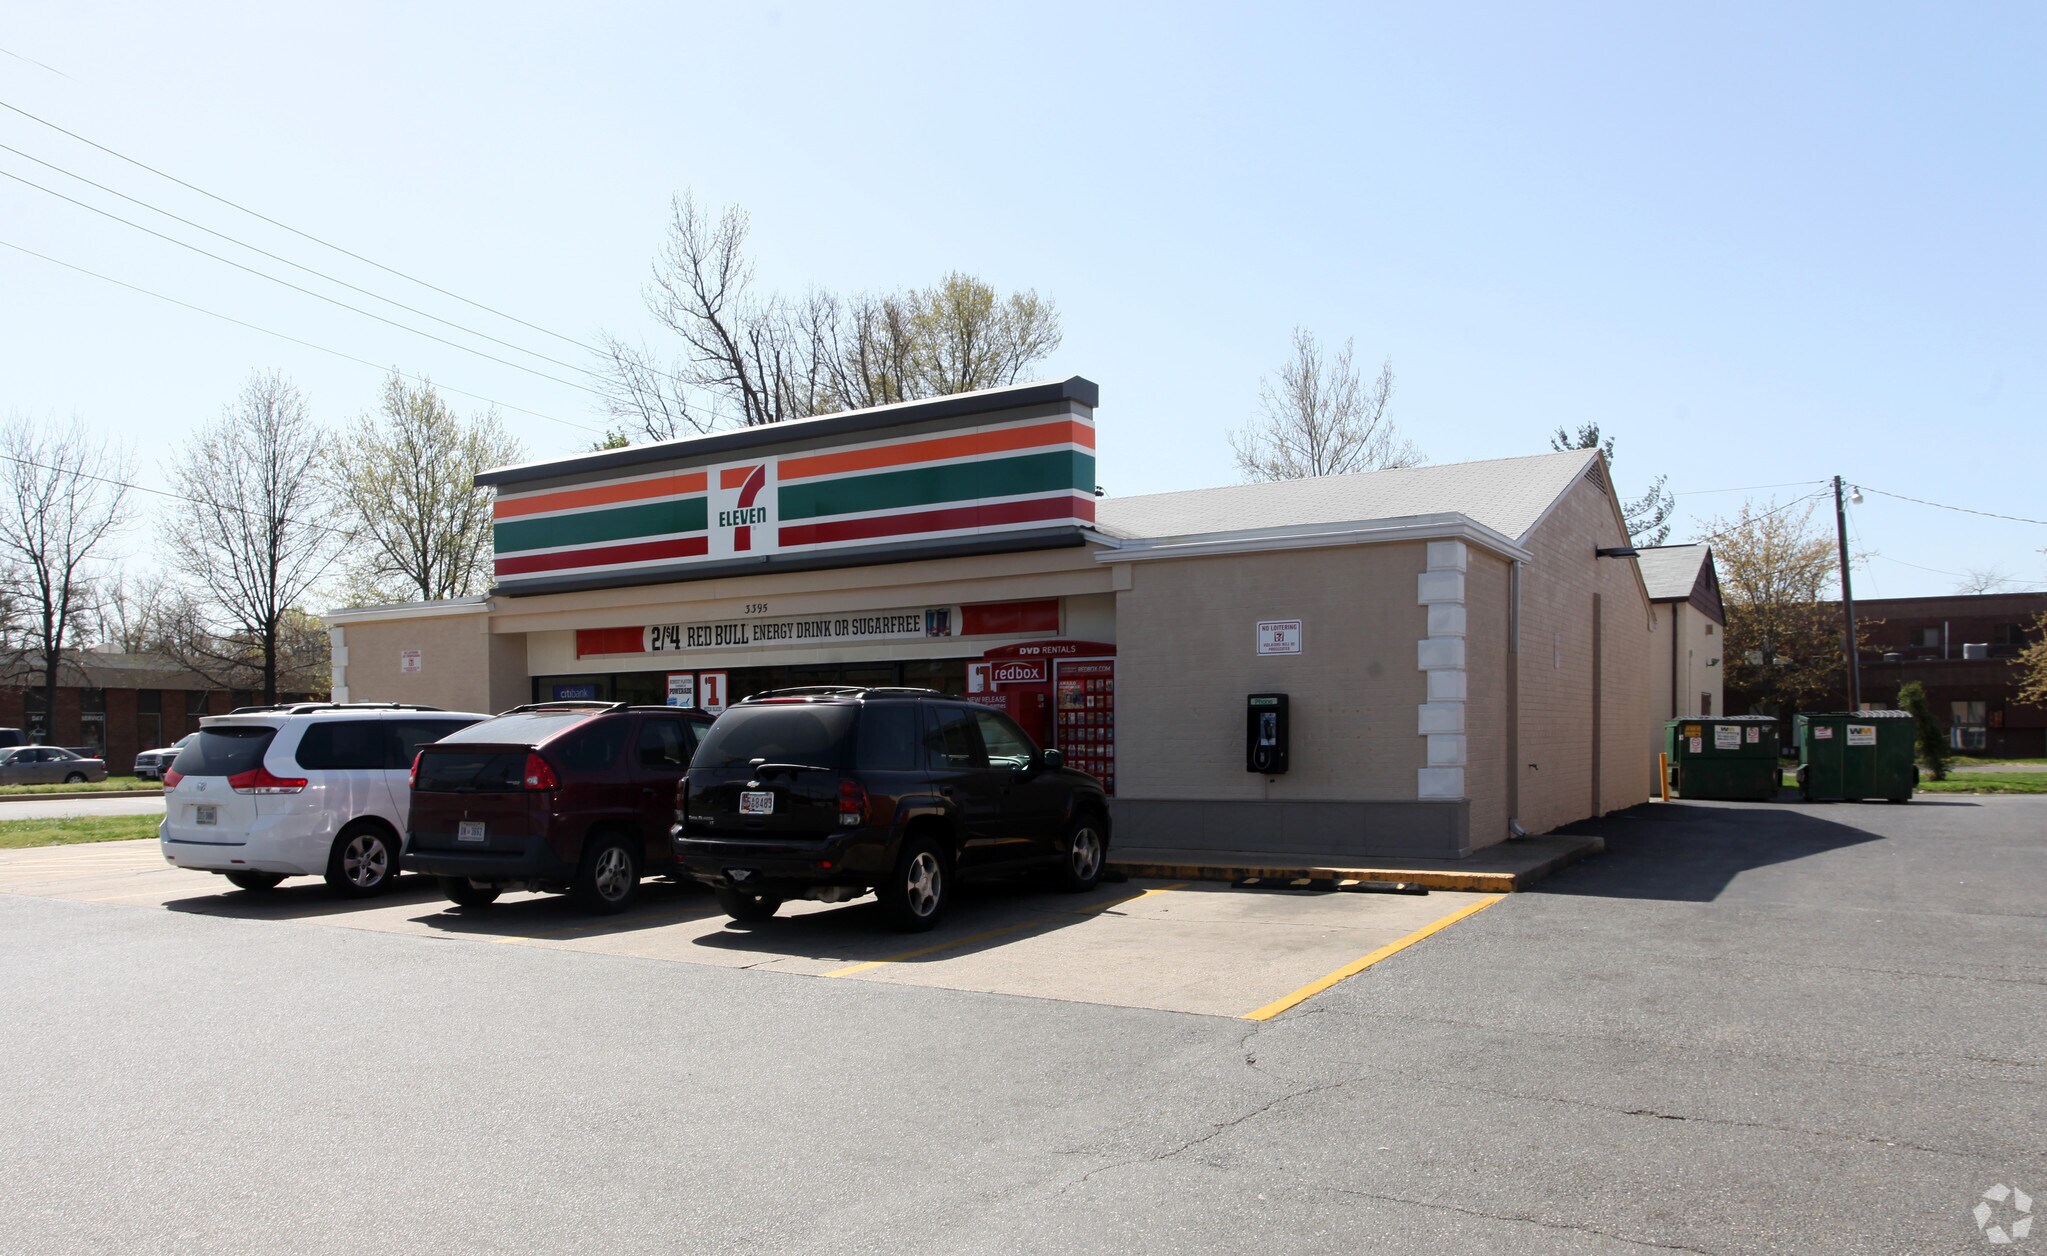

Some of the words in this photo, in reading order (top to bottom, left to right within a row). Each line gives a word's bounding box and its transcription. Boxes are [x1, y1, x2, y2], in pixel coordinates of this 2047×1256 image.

[744, 603, 768, 614] 3395
[687, 626, 712, 647] RED
[715, 623, 749, 645] BULL
[753, 622, 793, 641] ENERGY
[796, 620, 831, 639] DRINK
[834, 620, 849, 636] OR
[852, 615, 920, 635] SUGARFREE
[1019, 647, 1040, 655] DVD
[1042, 645, 1076, 654] RENTALS
[995, 666, 1039, 679] redbox
[560, 688, 588, 699] citibank
